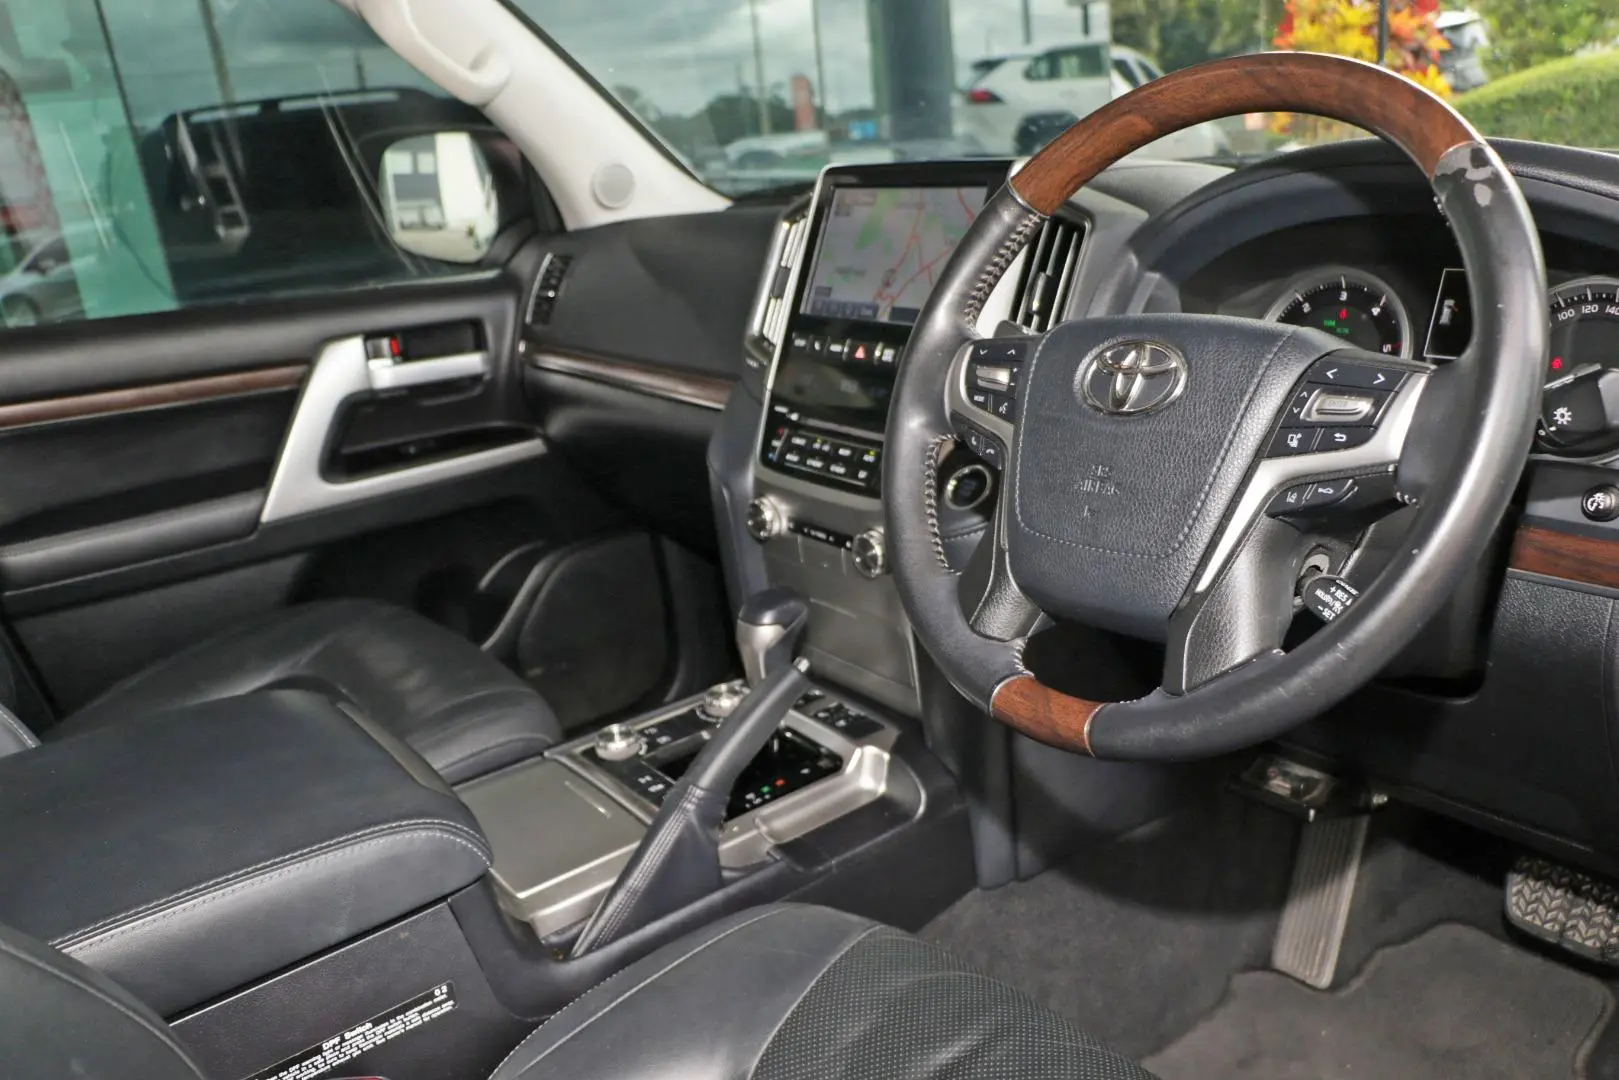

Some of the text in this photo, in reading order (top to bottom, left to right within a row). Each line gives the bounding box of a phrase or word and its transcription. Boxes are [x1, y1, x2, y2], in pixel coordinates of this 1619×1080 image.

[1340, 291, 1347, 300] 3
[1302, 302, 1311, 313] 2
[1371, 307, 1380, 316] 4
[1582, 304, 1598, 313] 120
[1557, 309, 1575, 320] 100
[1383, 343, 1391, 352] 5
[1322, 608, 1336, 620] SET
